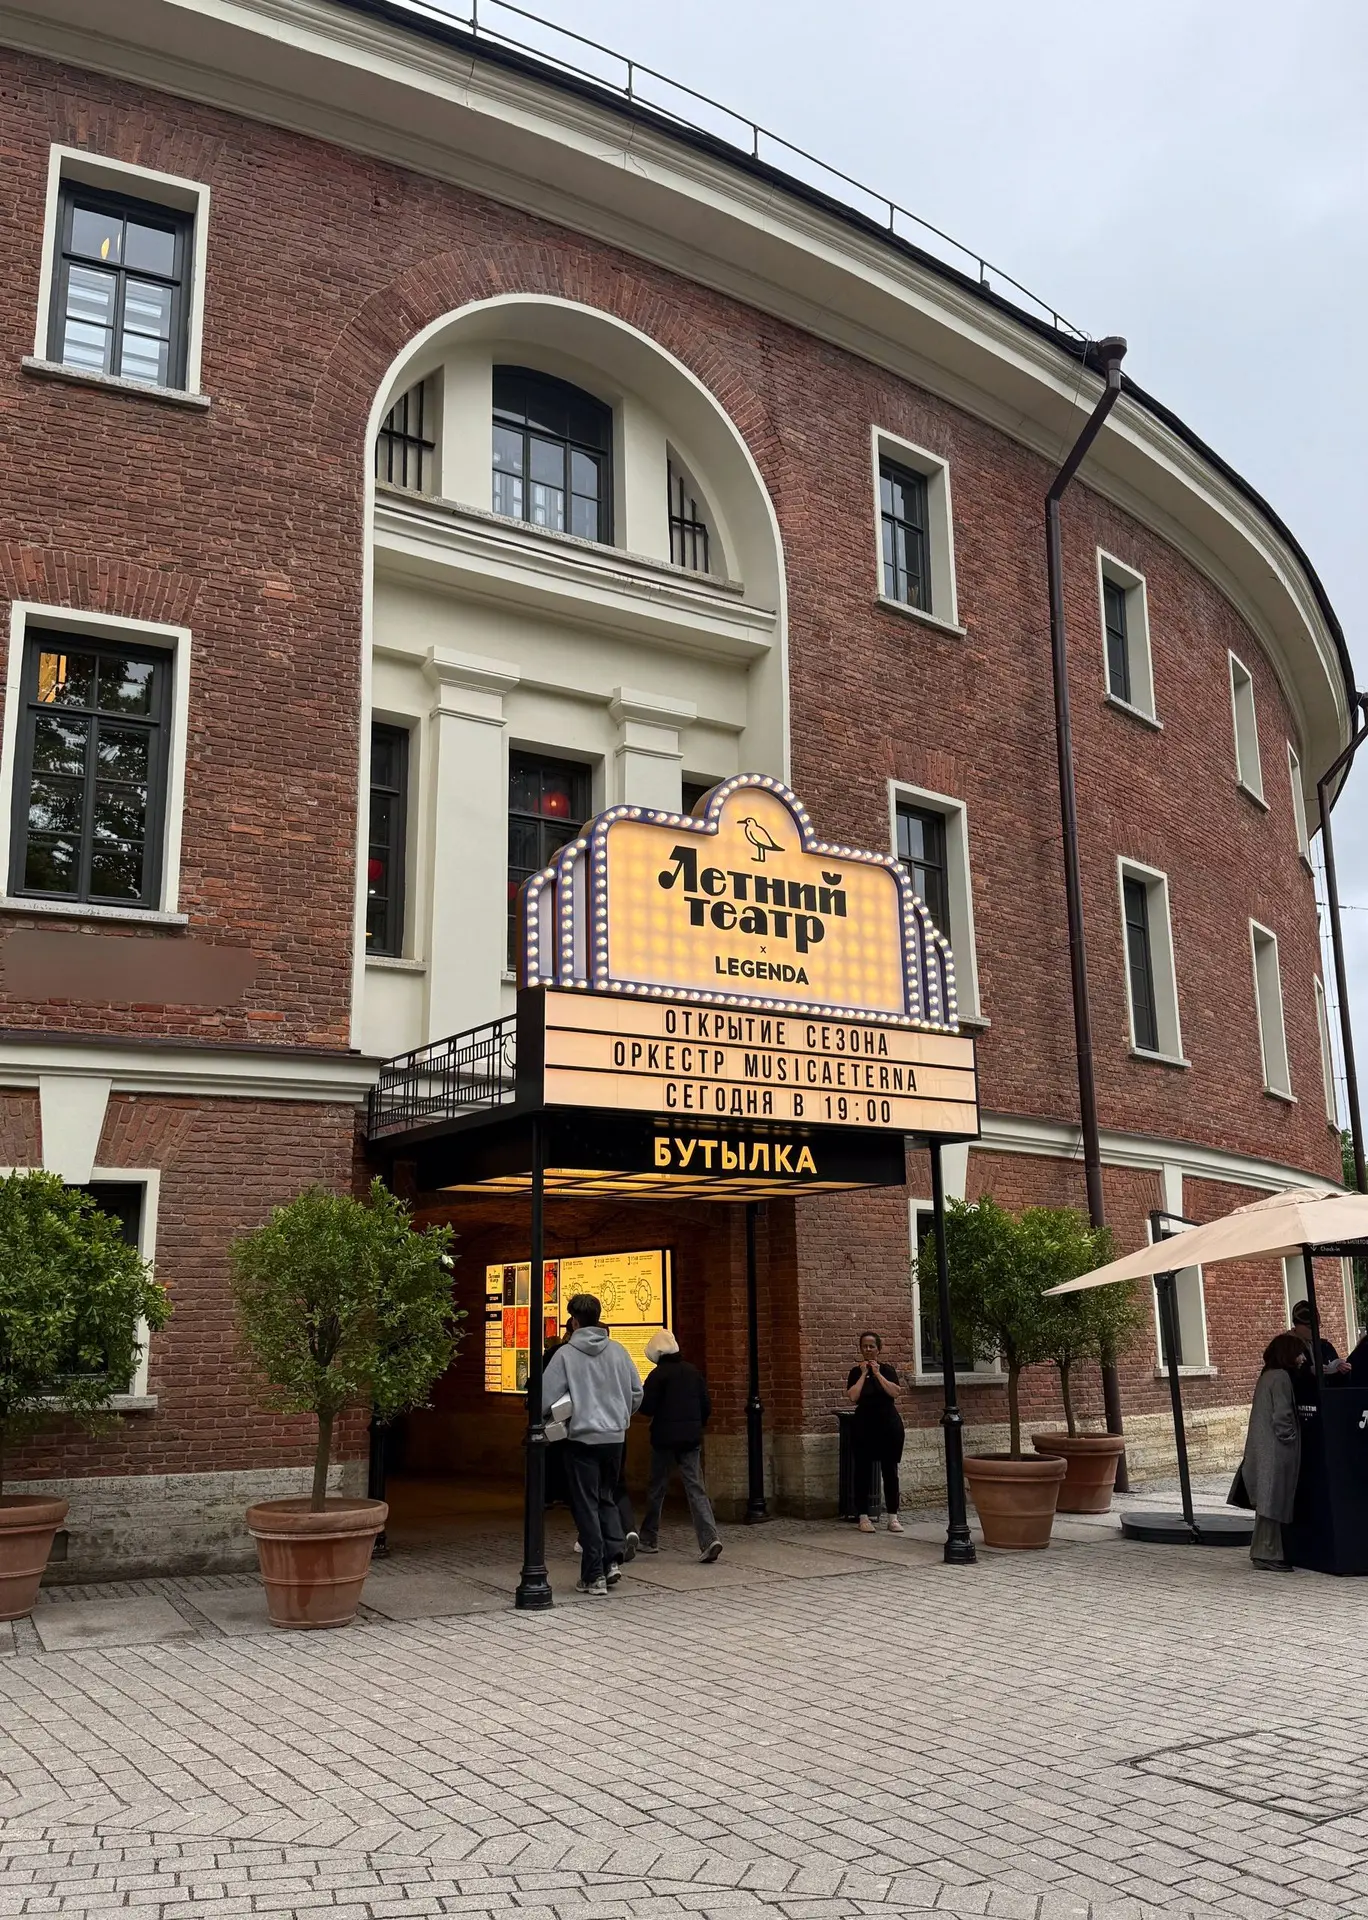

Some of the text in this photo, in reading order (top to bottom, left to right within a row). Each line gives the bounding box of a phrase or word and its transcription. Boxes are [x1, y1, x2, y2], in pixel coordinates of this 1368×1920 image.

[659, 845, 847, 917] Летний
[683, 896, 825, 954] театр
[715, 956, 809, 986] LEGENDA
[665, 1009, 888, 1056] ОТКРЫТИЕ СЕЗОНА
[614, 1040, 917, 1092] ОРКЕСТР MUSICAETERNA
[666, 1082, 891, 1124] СЕГОДНЯ В 19:00
[654, 1136, 818, 1174] БУТЫЛКА
